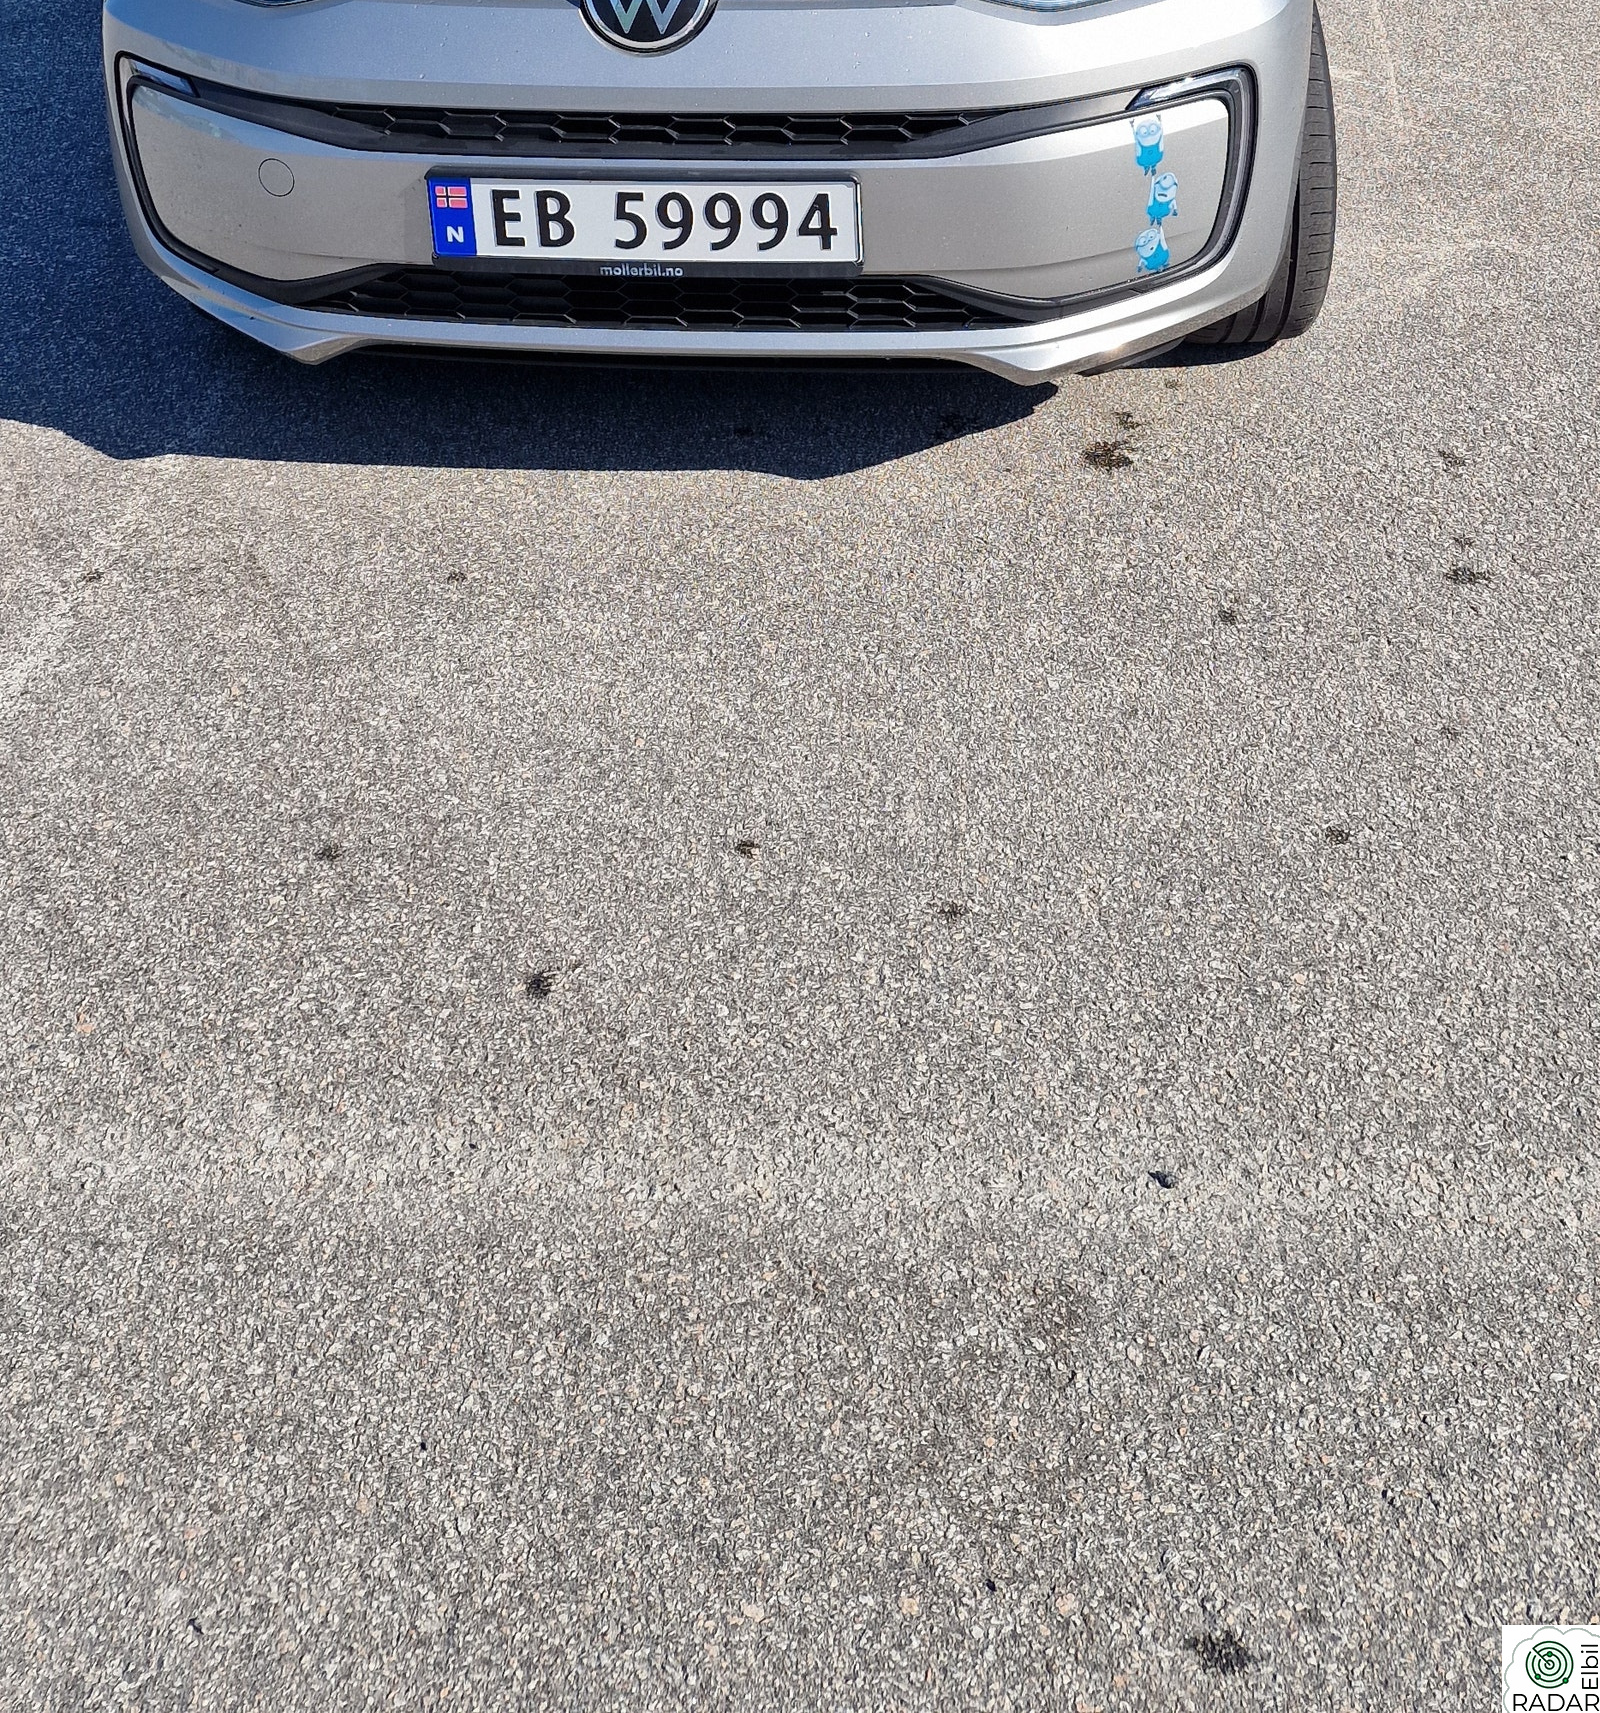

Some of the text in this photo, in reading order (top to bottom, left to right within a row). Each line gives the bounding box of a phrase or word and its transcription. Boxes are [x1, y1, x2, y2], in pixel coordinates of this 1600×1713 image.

[446, 225, 464, 244] N
[490, 188, 837, 251] EB 59994
